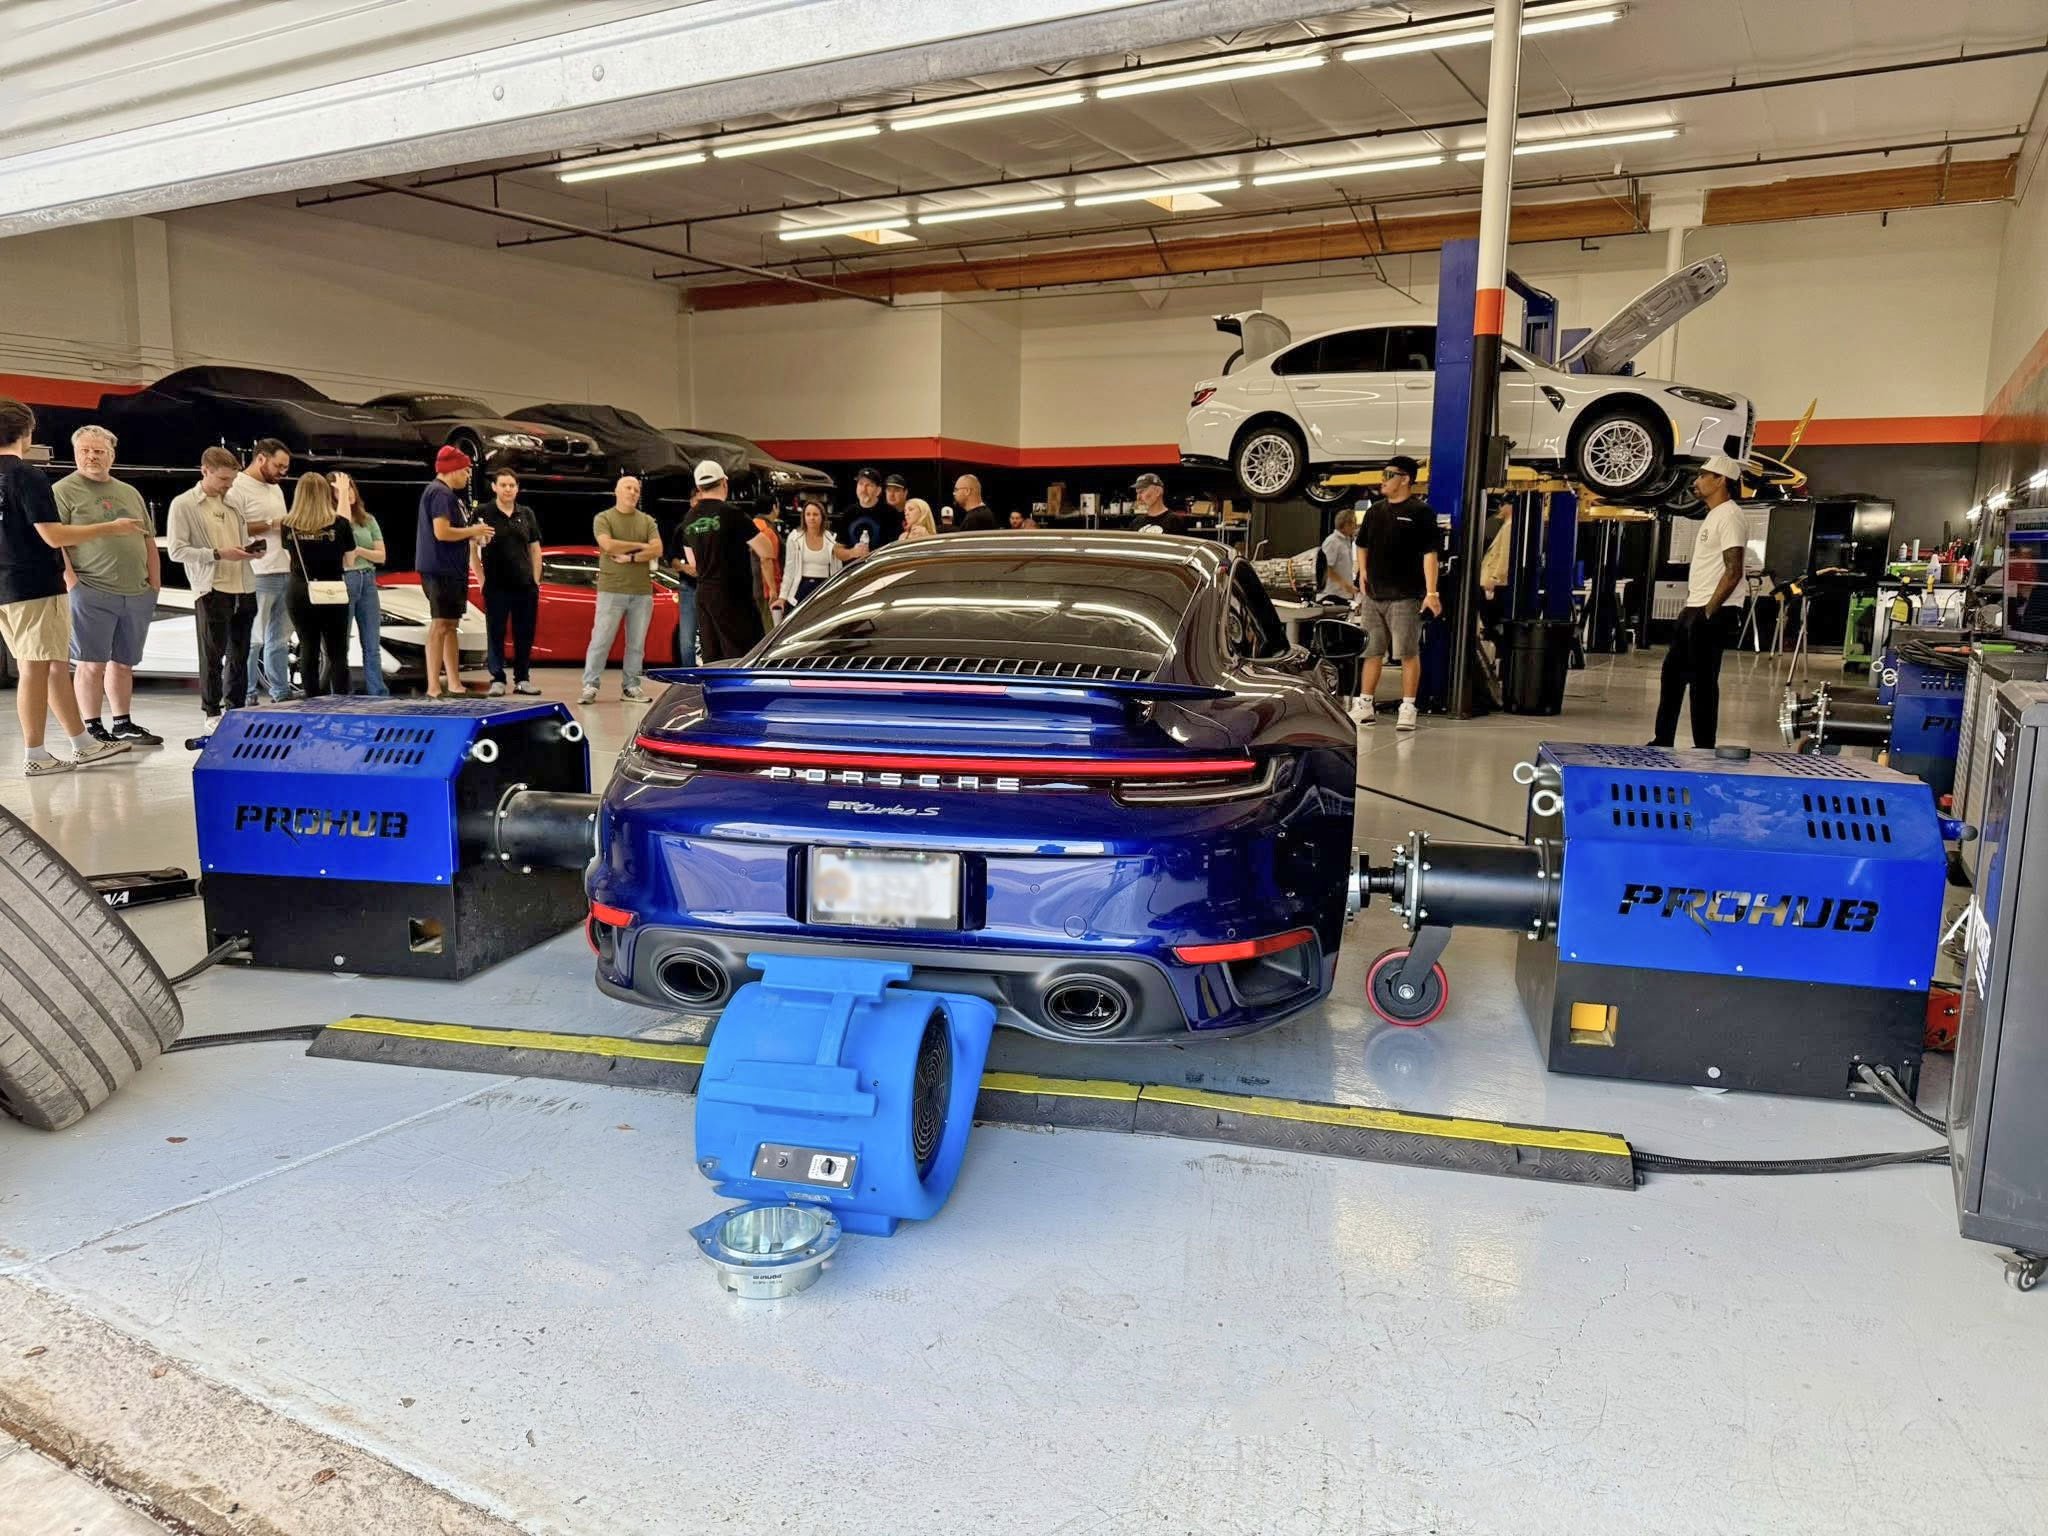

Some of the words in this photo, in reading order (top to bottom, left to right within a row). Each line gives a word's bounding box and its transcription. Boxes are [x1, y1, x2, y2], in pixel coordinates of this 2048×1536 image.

[771, 767, 1020, 791] PORSCHE
[235, 805, 408, 847] PROHUB
[916, 807, 940, 816] S
[1618, 883, 1880, 937] PROHUB
